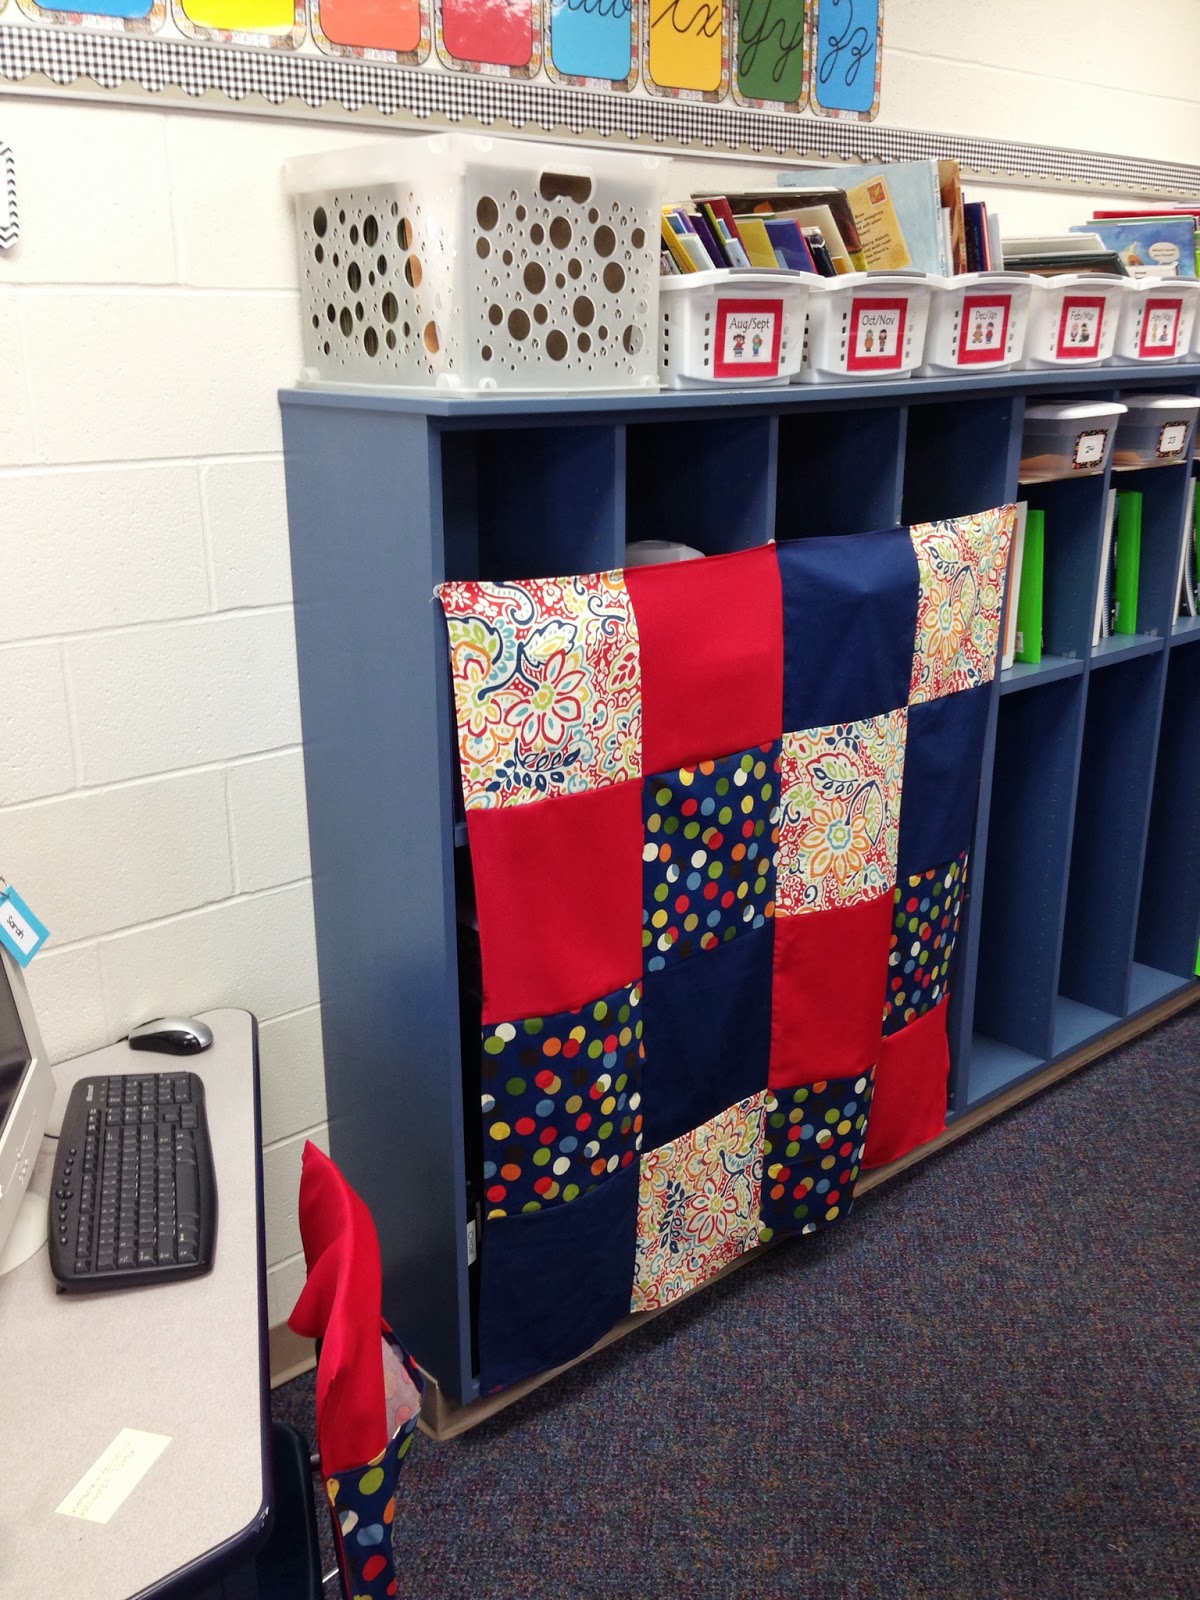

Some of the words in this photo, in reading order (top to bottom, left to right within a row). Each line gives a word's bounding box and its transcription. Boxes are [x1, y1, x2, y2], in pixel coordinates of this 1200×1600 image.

[861, 314, 895, 327] Oct/Nov
[975, 310, 998, 321] Dec/Jan
[1070, 310, 1095, 321] Feb/Mar
[729, 317, 770, 333] Aug/Sept
[1085, 445, 1095, 454] 24
[7, 915, 24, 940] Sarah
